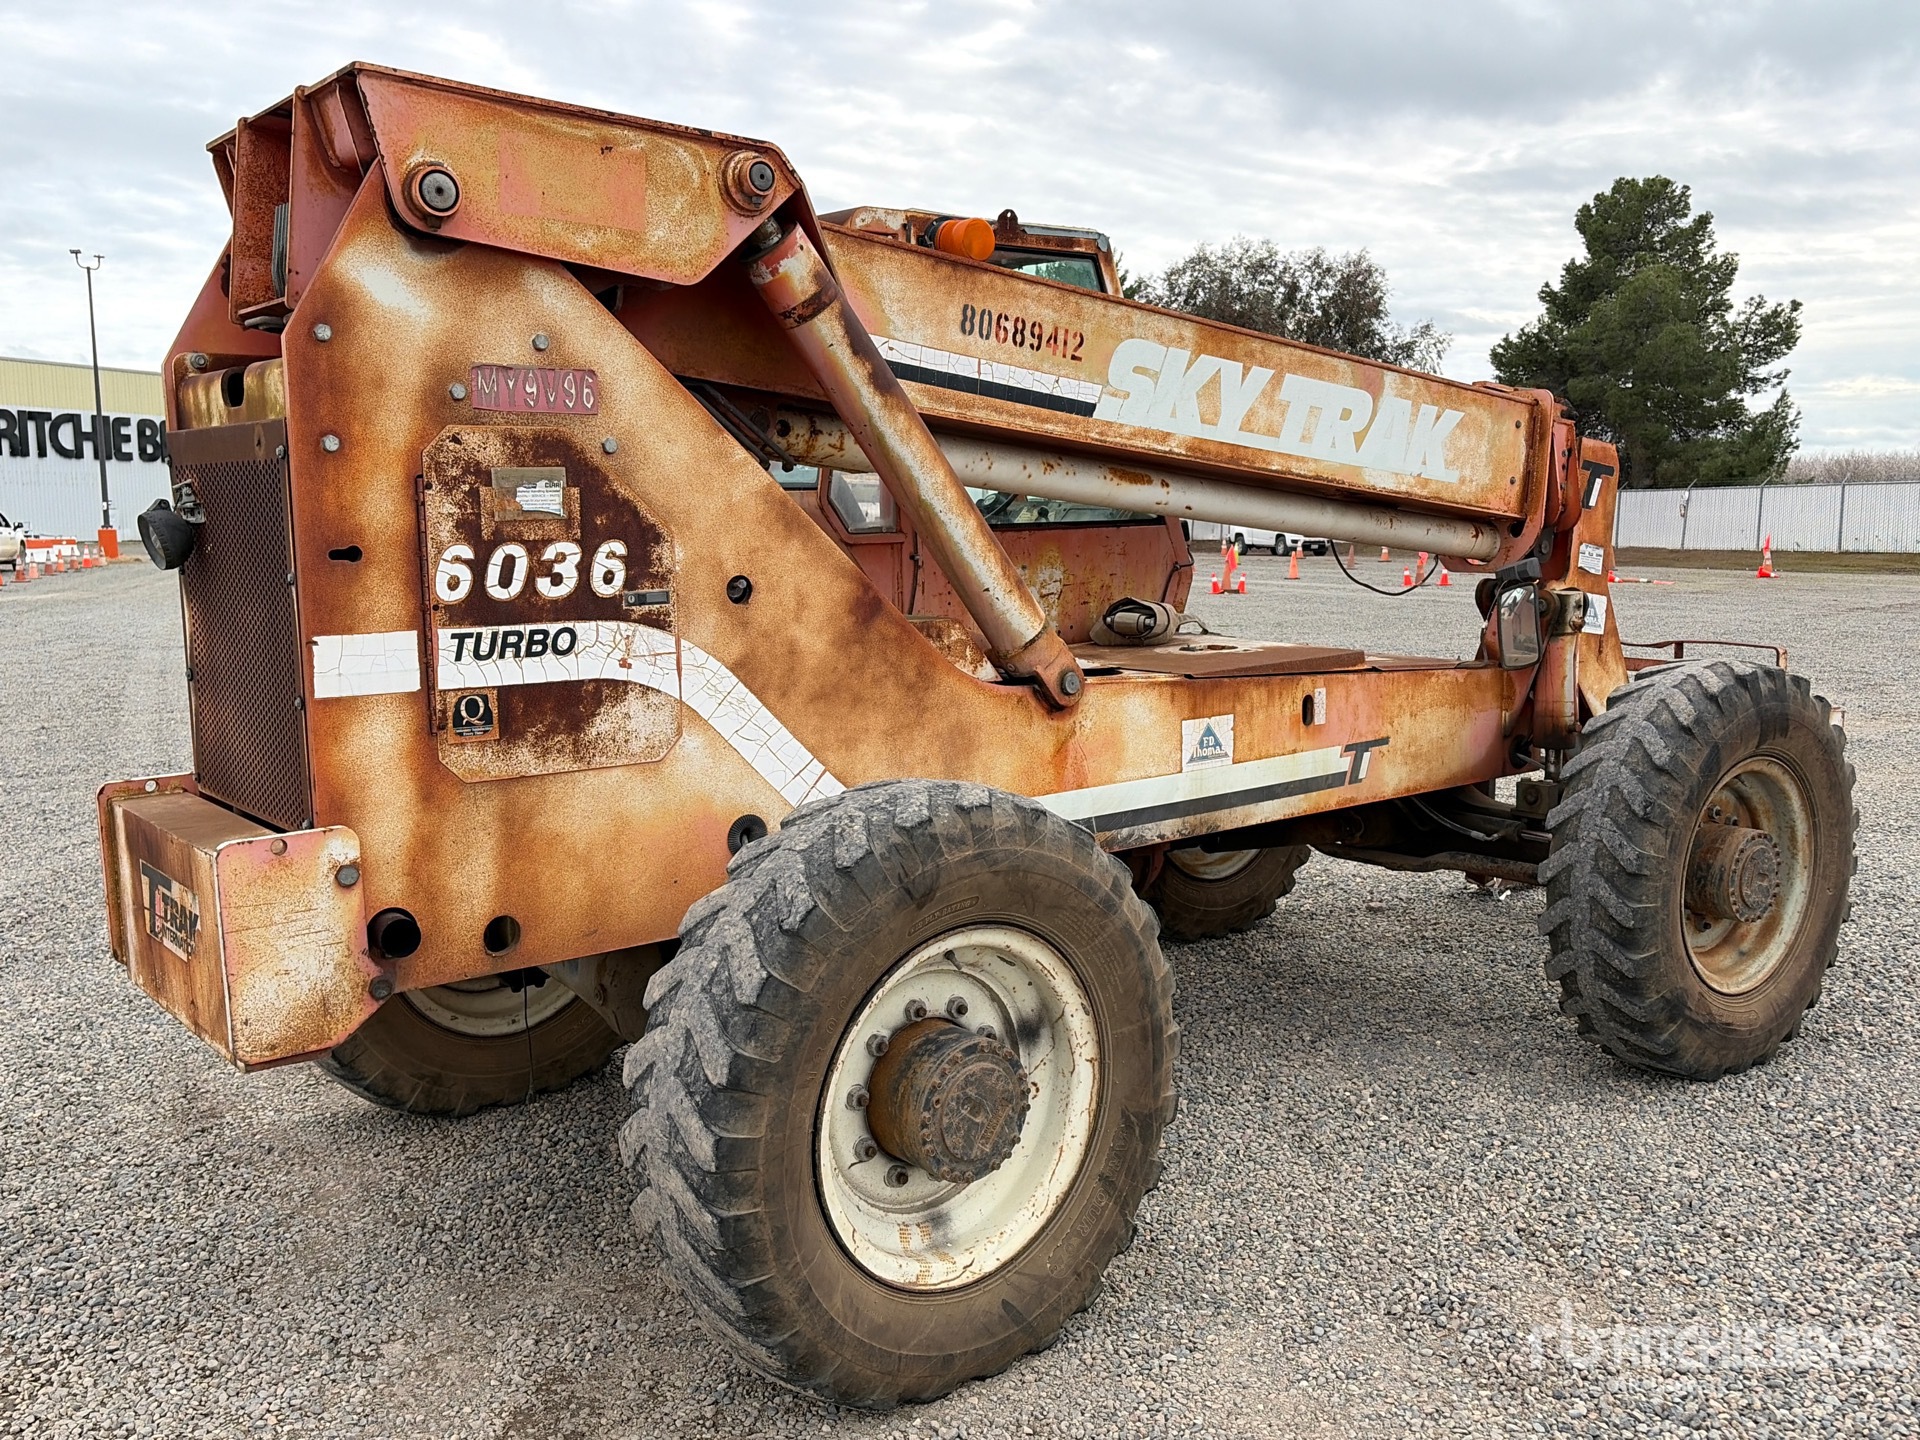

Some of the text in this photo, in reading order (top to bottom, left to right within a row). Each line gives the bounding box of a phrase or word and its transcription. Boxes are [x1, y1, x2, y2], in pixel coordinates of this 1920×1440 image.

[961, 303, 1085, 362] 80689412
[0, 409, 133, 462] RITCHIE
[435, 540, 629, 602] 6036
[450, 627, 577, 662] TURBO
[460, 695, 486, 726] Q
